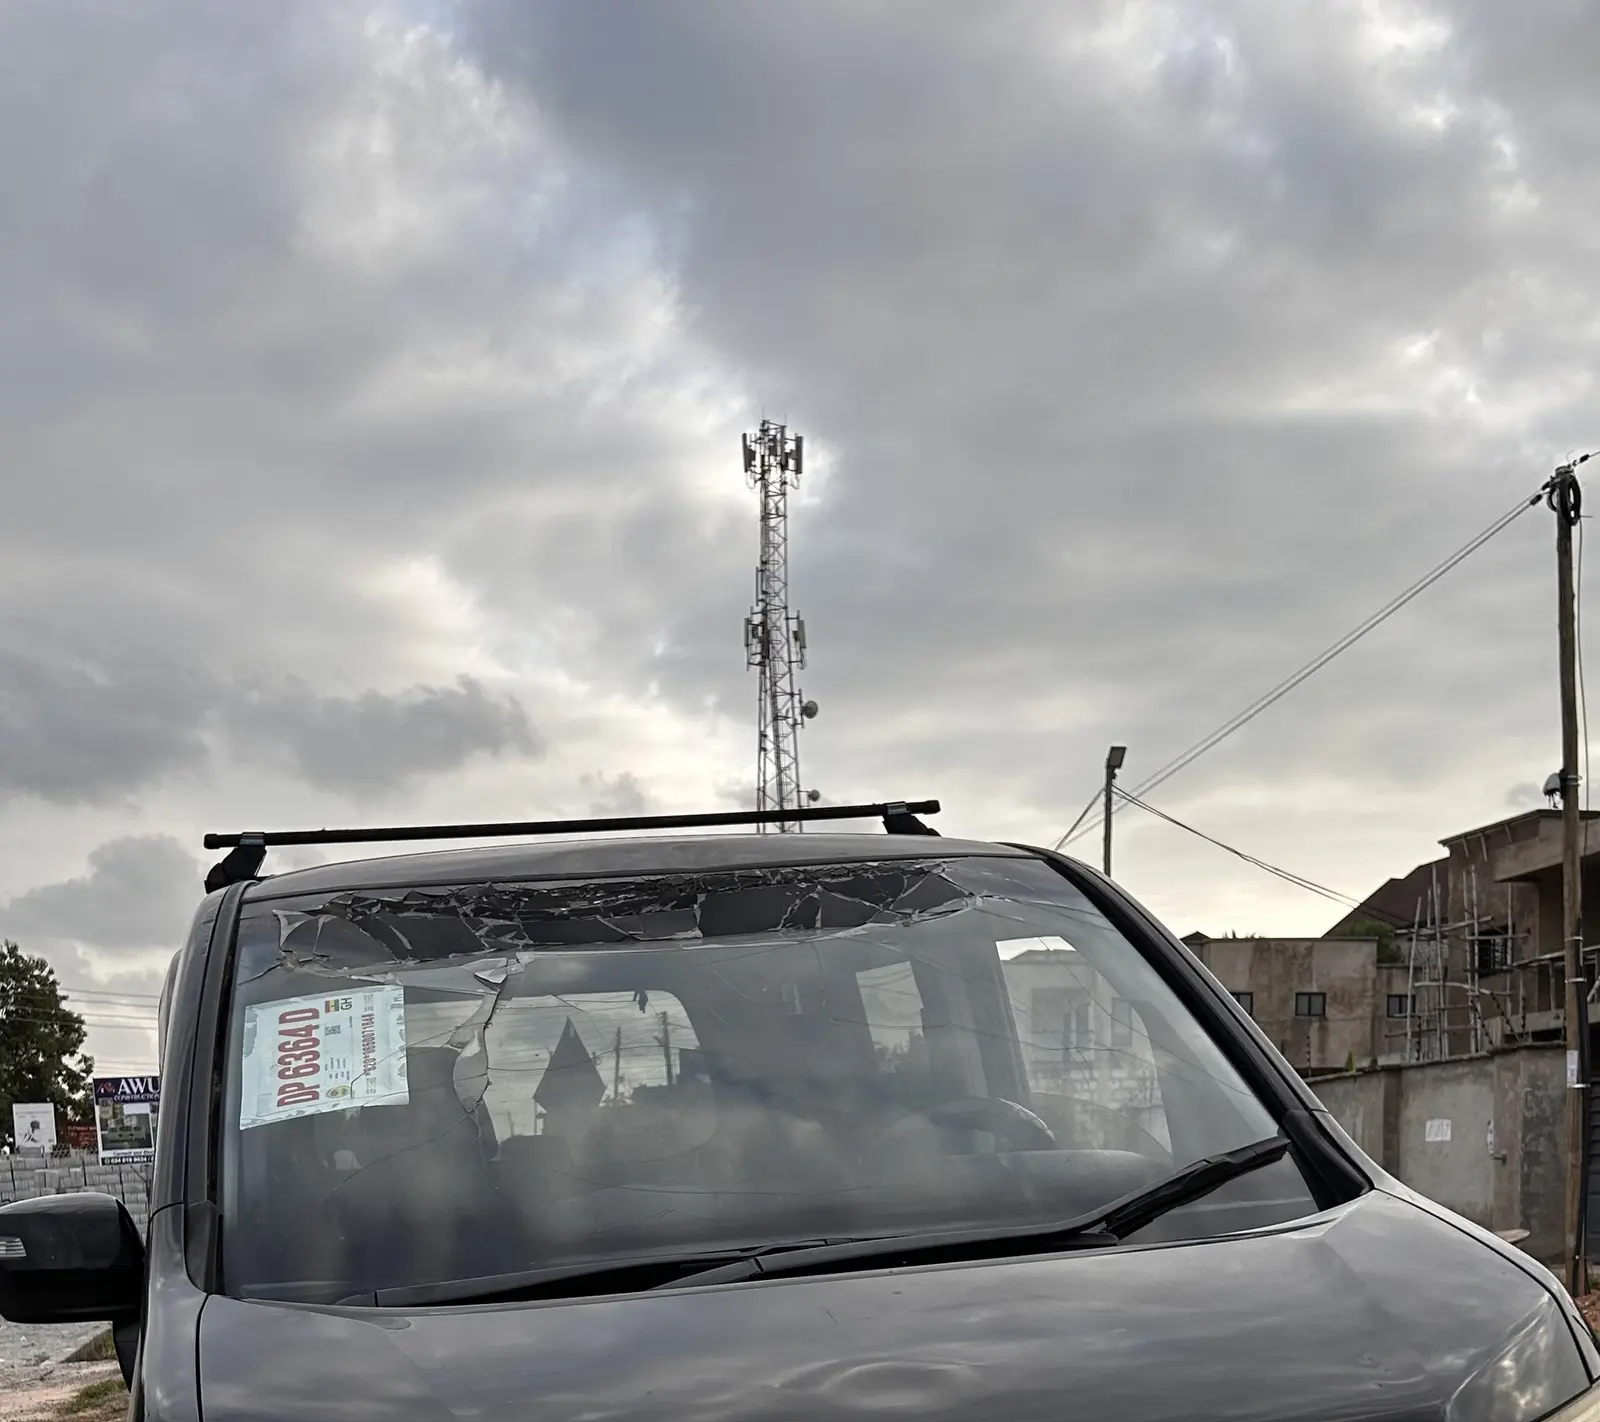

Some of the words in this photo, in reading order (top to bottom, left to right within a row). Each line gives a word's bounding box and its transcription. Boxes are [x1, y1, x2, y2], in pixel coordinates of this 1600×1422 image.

[341, 997, 352, 1010] GH
[278, 1007, 320, 1024] D
[277, 1024, 320, 1080] 6364
[277, 1082, 320, 1107] DP
